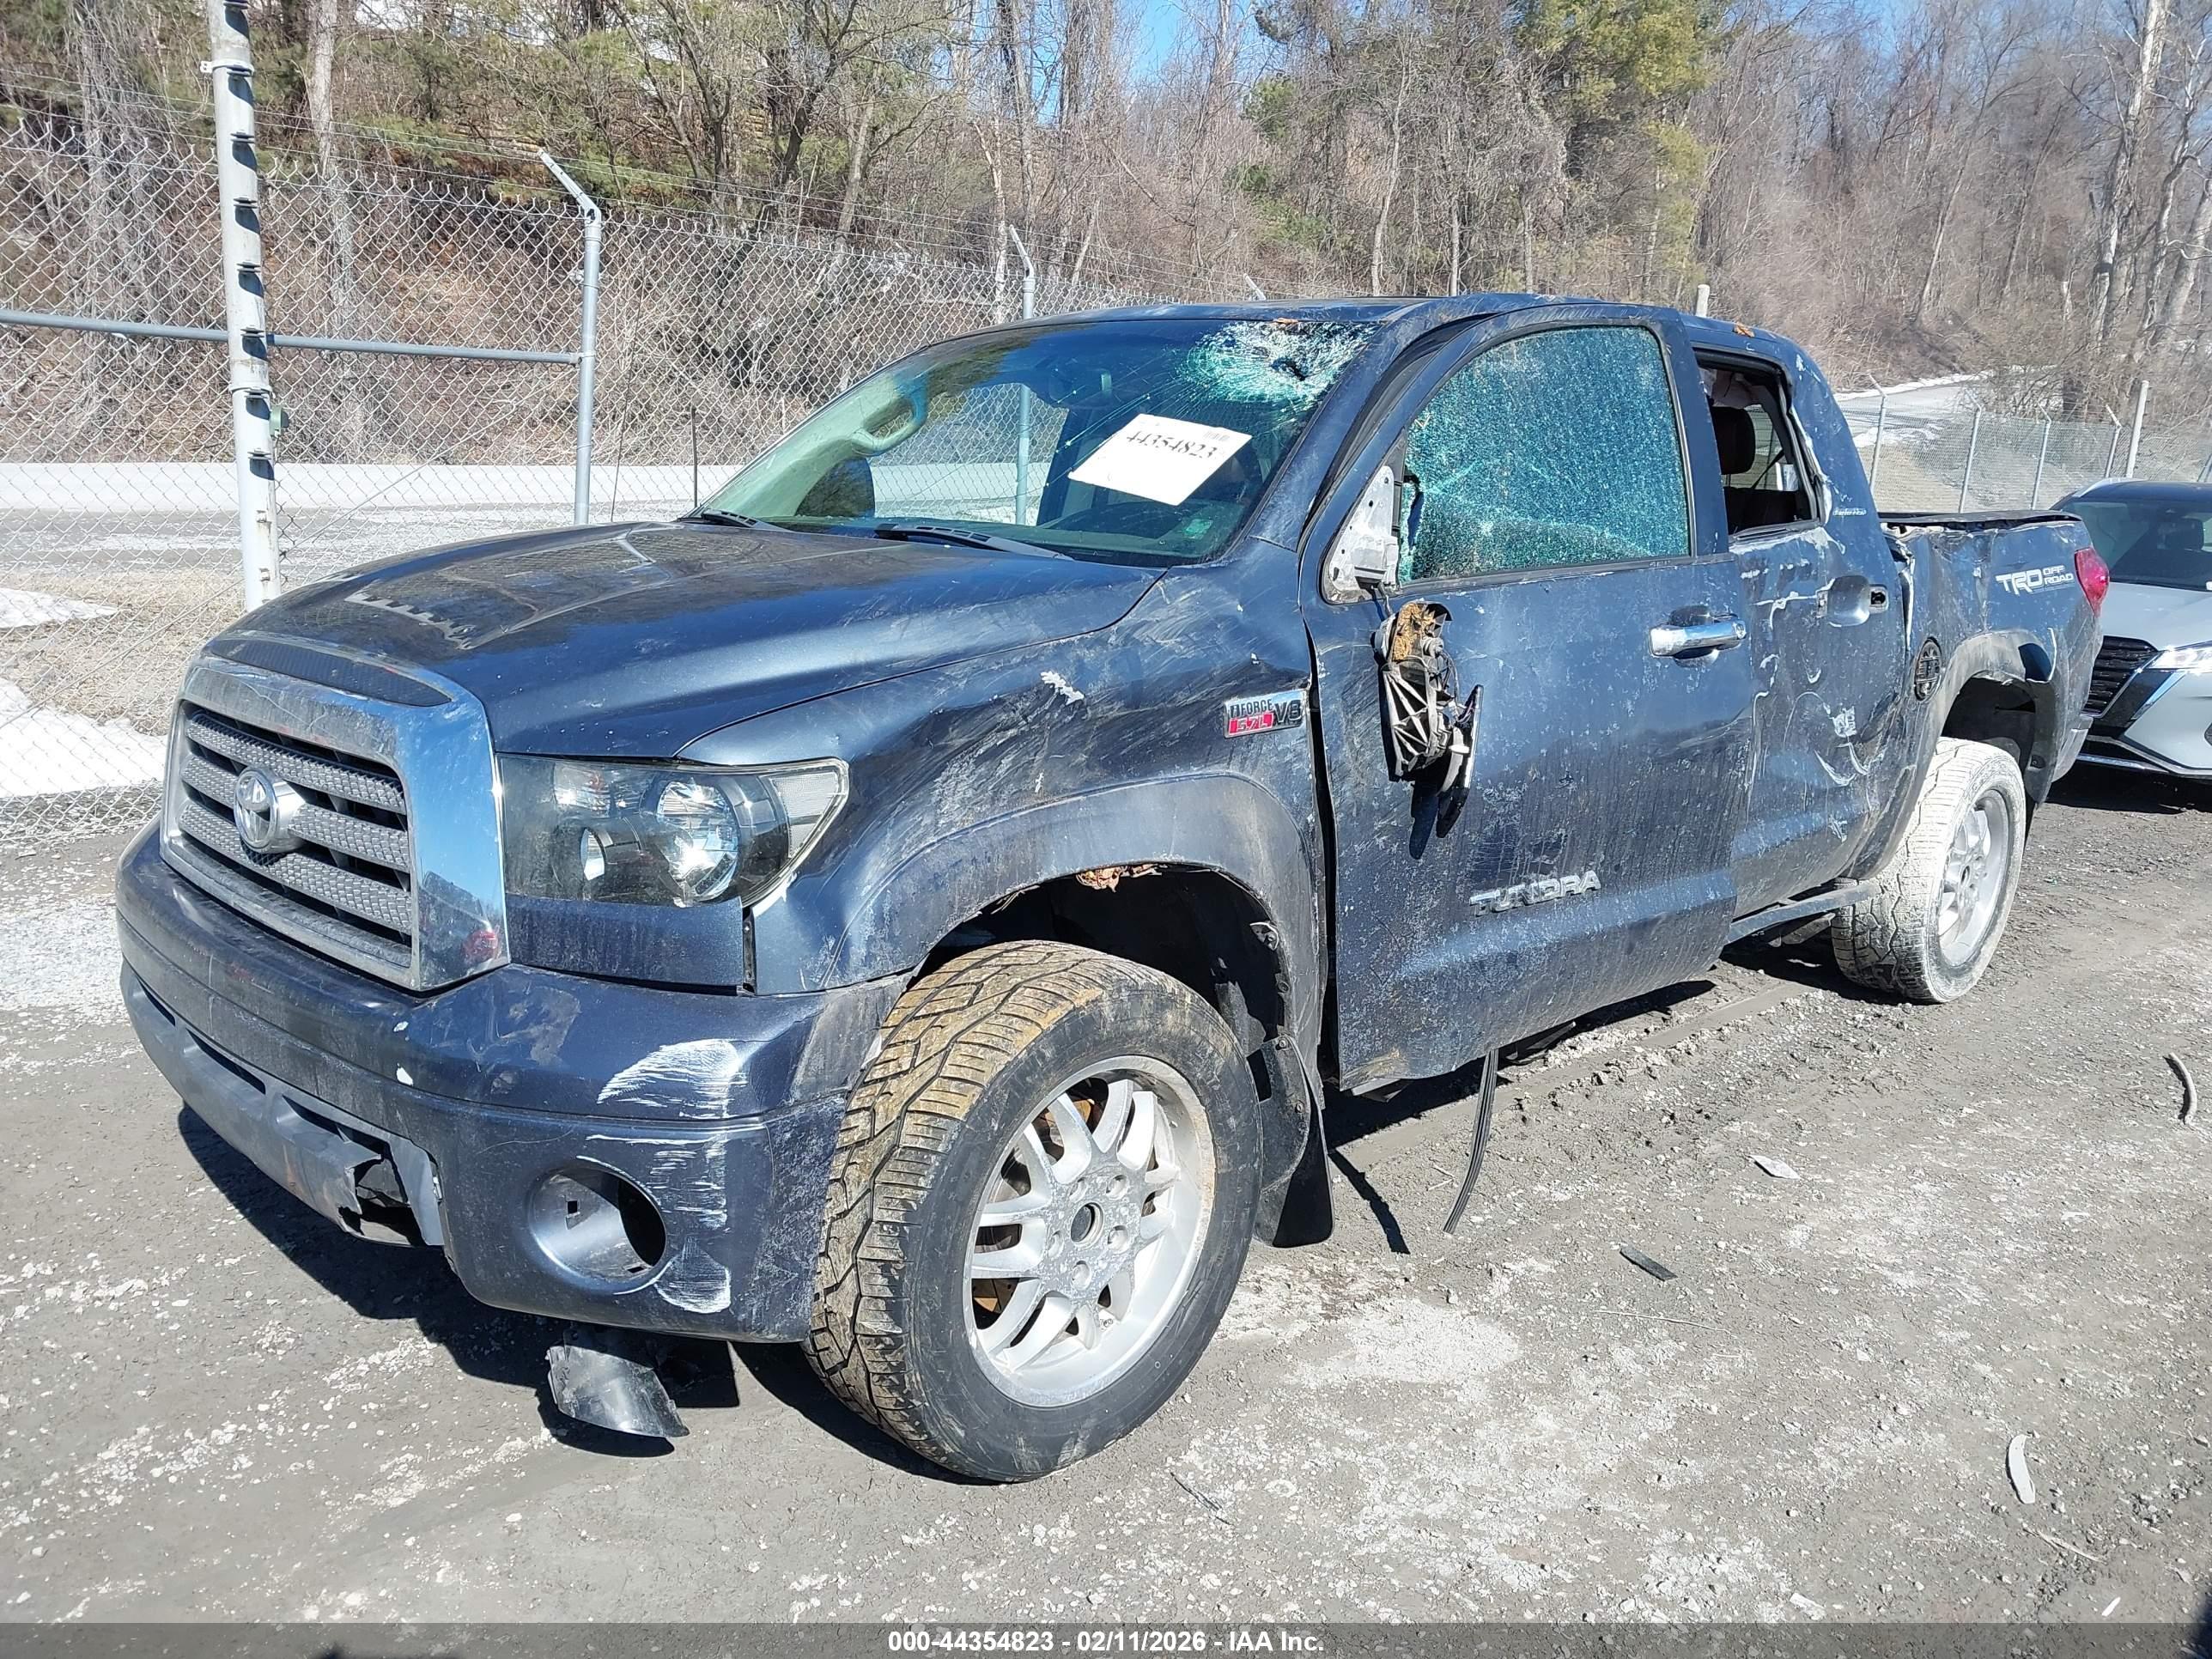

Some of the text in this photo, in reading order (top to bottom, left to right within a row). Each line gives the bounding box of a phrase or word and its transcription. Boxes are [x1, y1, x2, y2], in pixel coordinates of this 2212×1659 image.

[1127, 430, 1218, 459] 44354823
[1995, 568, 2044, 596] TRD
[2043, 565, 2065, 576] OFF
[2044, 573, 2075, 586] ROAD
[1273, 699, 1303, 725] V8
[1469, 870, 1601, 917] TUNDRA
